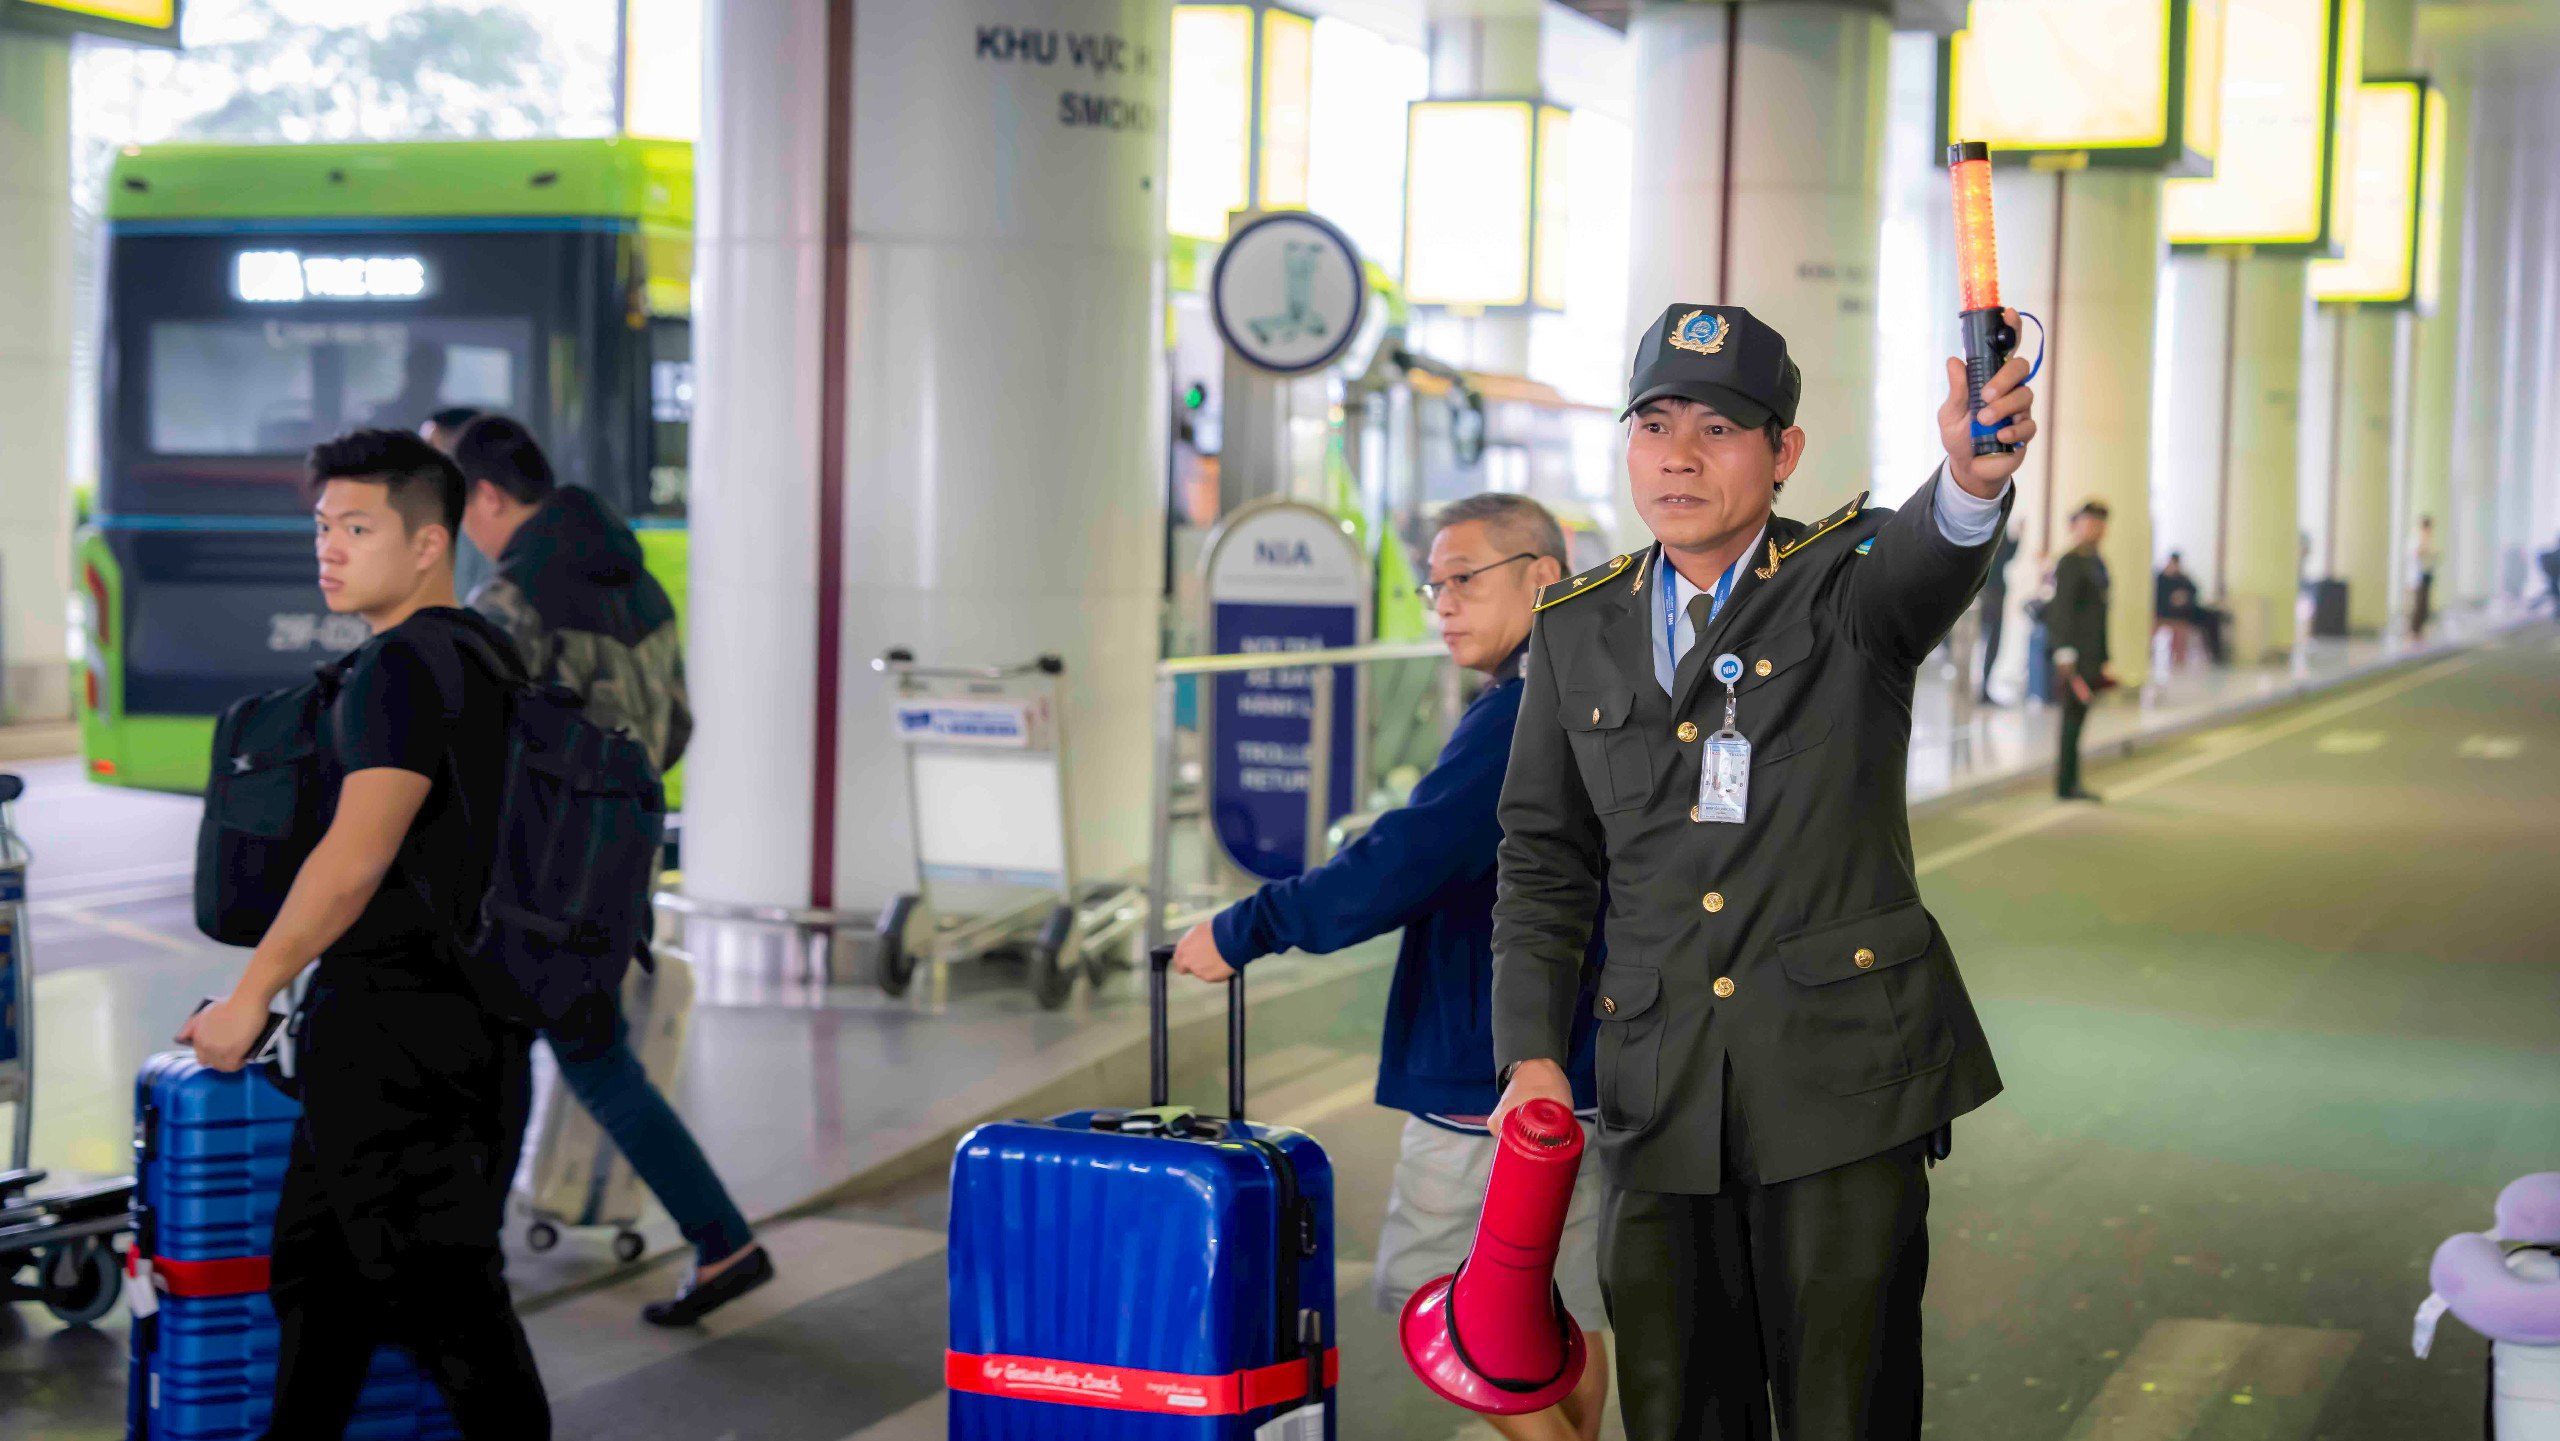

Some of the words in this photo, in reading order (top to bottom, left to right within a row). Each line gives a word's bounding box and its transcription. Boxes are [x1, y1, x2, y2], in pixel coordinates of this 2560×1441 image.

[975, 27, 1058, 65] KHU
[1254, 539, 1313, 567] NIA
[1722, 664, 1737, 675] NIA
